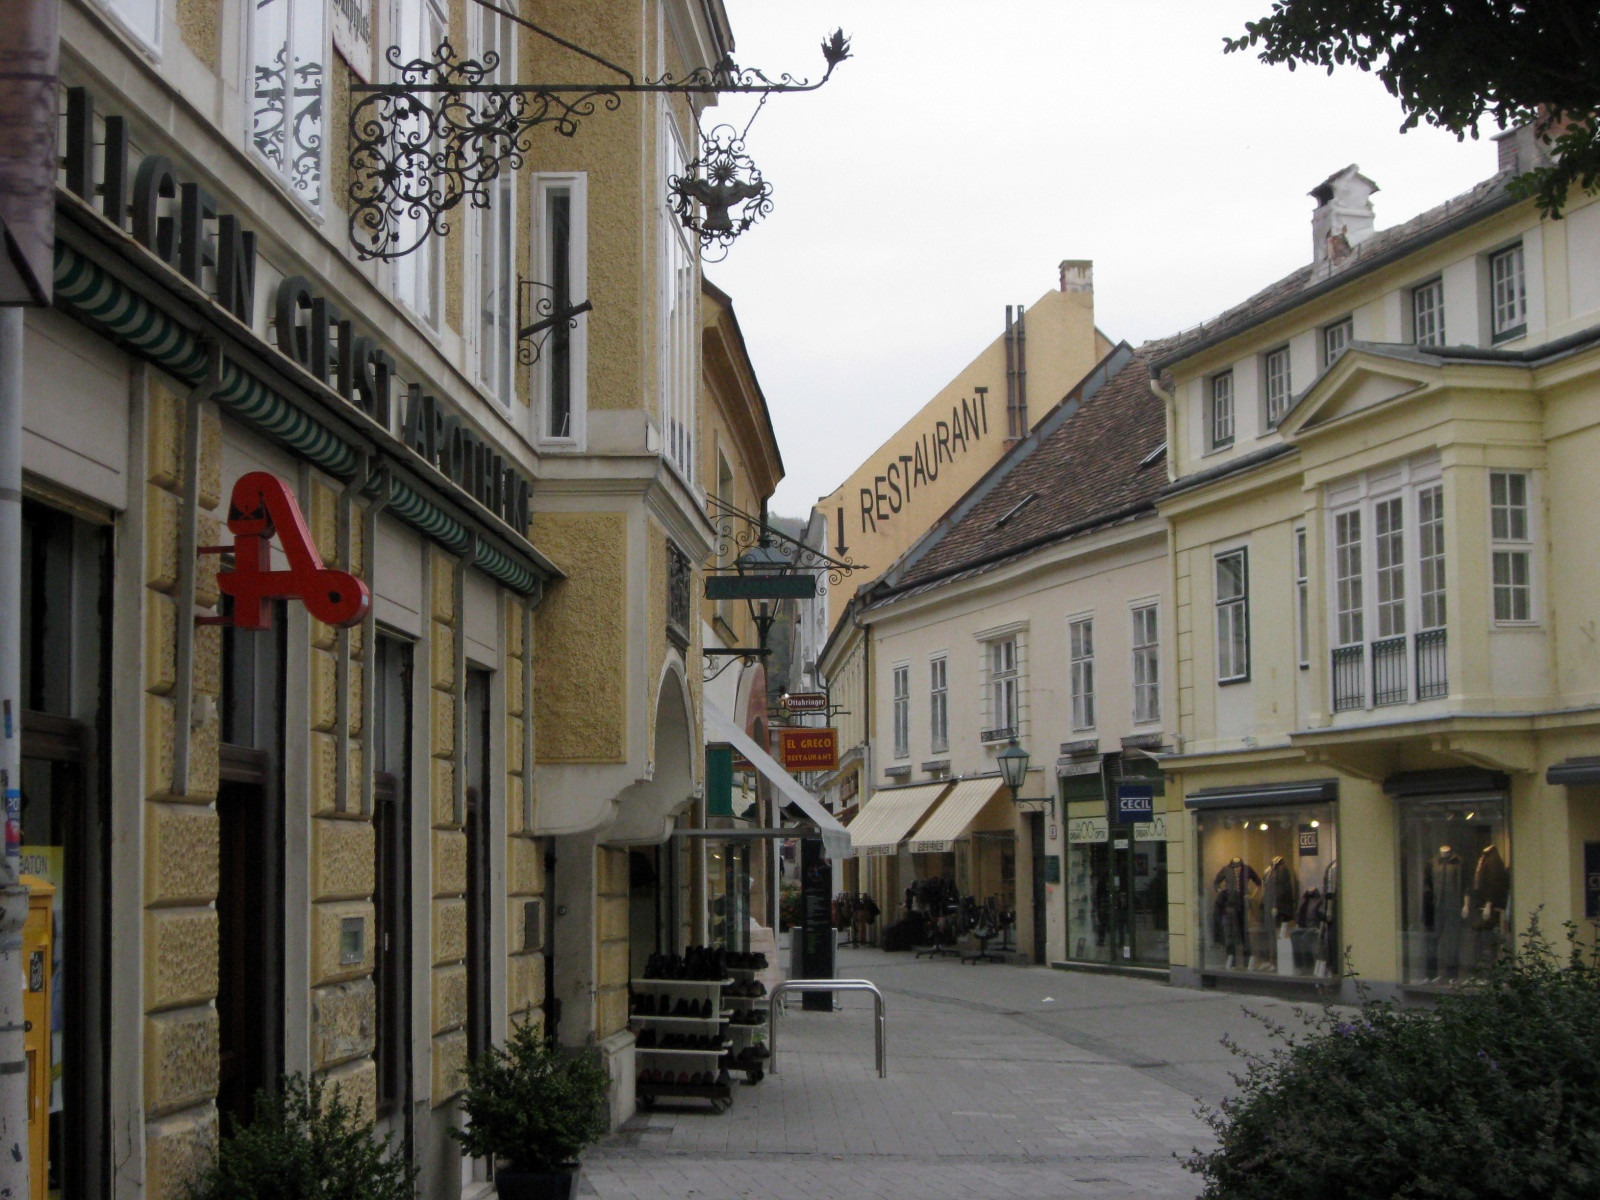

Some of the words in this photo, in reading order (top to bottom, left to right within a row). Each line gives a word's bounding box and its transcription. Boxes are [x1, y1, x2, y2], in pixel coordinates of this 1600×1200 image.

[276, 275, 395, 432] GEIST
[860, 386, 988, 533] RESTAURANT
[786, 740, 796, 749] EL
[800, 738, 832, 749] GRECO
[787, 753, 832, 762] RESTAURANT
[1120, 799, 1152, 809] CECIL
